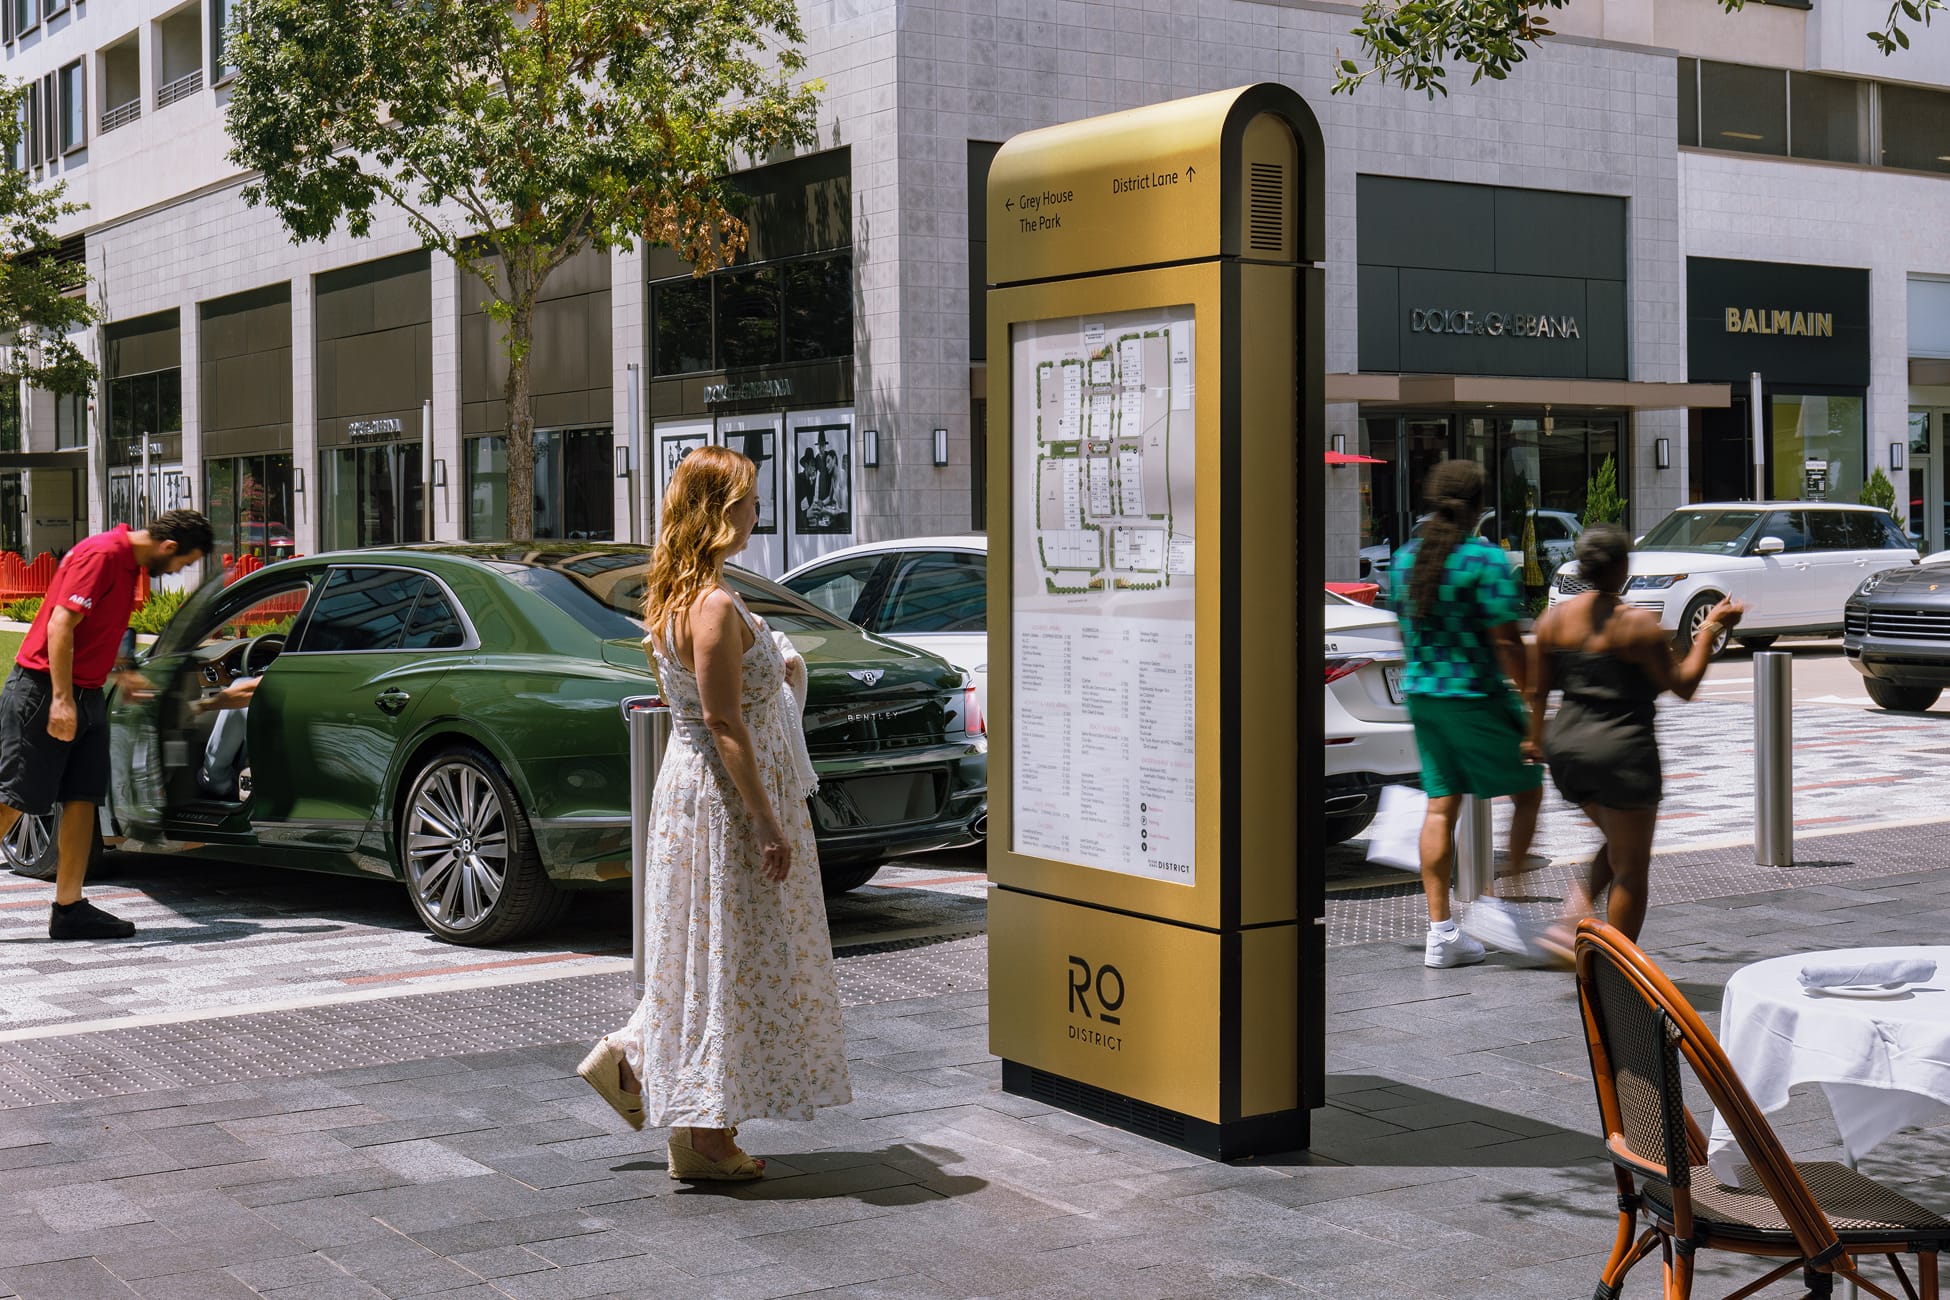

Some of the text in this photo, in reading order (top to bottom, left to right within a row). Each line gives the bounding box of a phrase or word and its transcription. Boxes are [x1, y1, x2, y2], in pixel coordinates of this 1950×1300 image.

[1113, 170, 1179, 194] District Lane
[1019, 189, 1074, 212] Grey House
[1020, 213, 1061, 233] The Park
[1725, 307, 1833, 337] BALMAIN
[847, 711, 898, 722] BENTLEY
[1158, 861, 1190, 874] DISTRICT
[1068, 955, 1125, 1026] RO
[1068, 1025, 1123, 1052] DISTRICT
